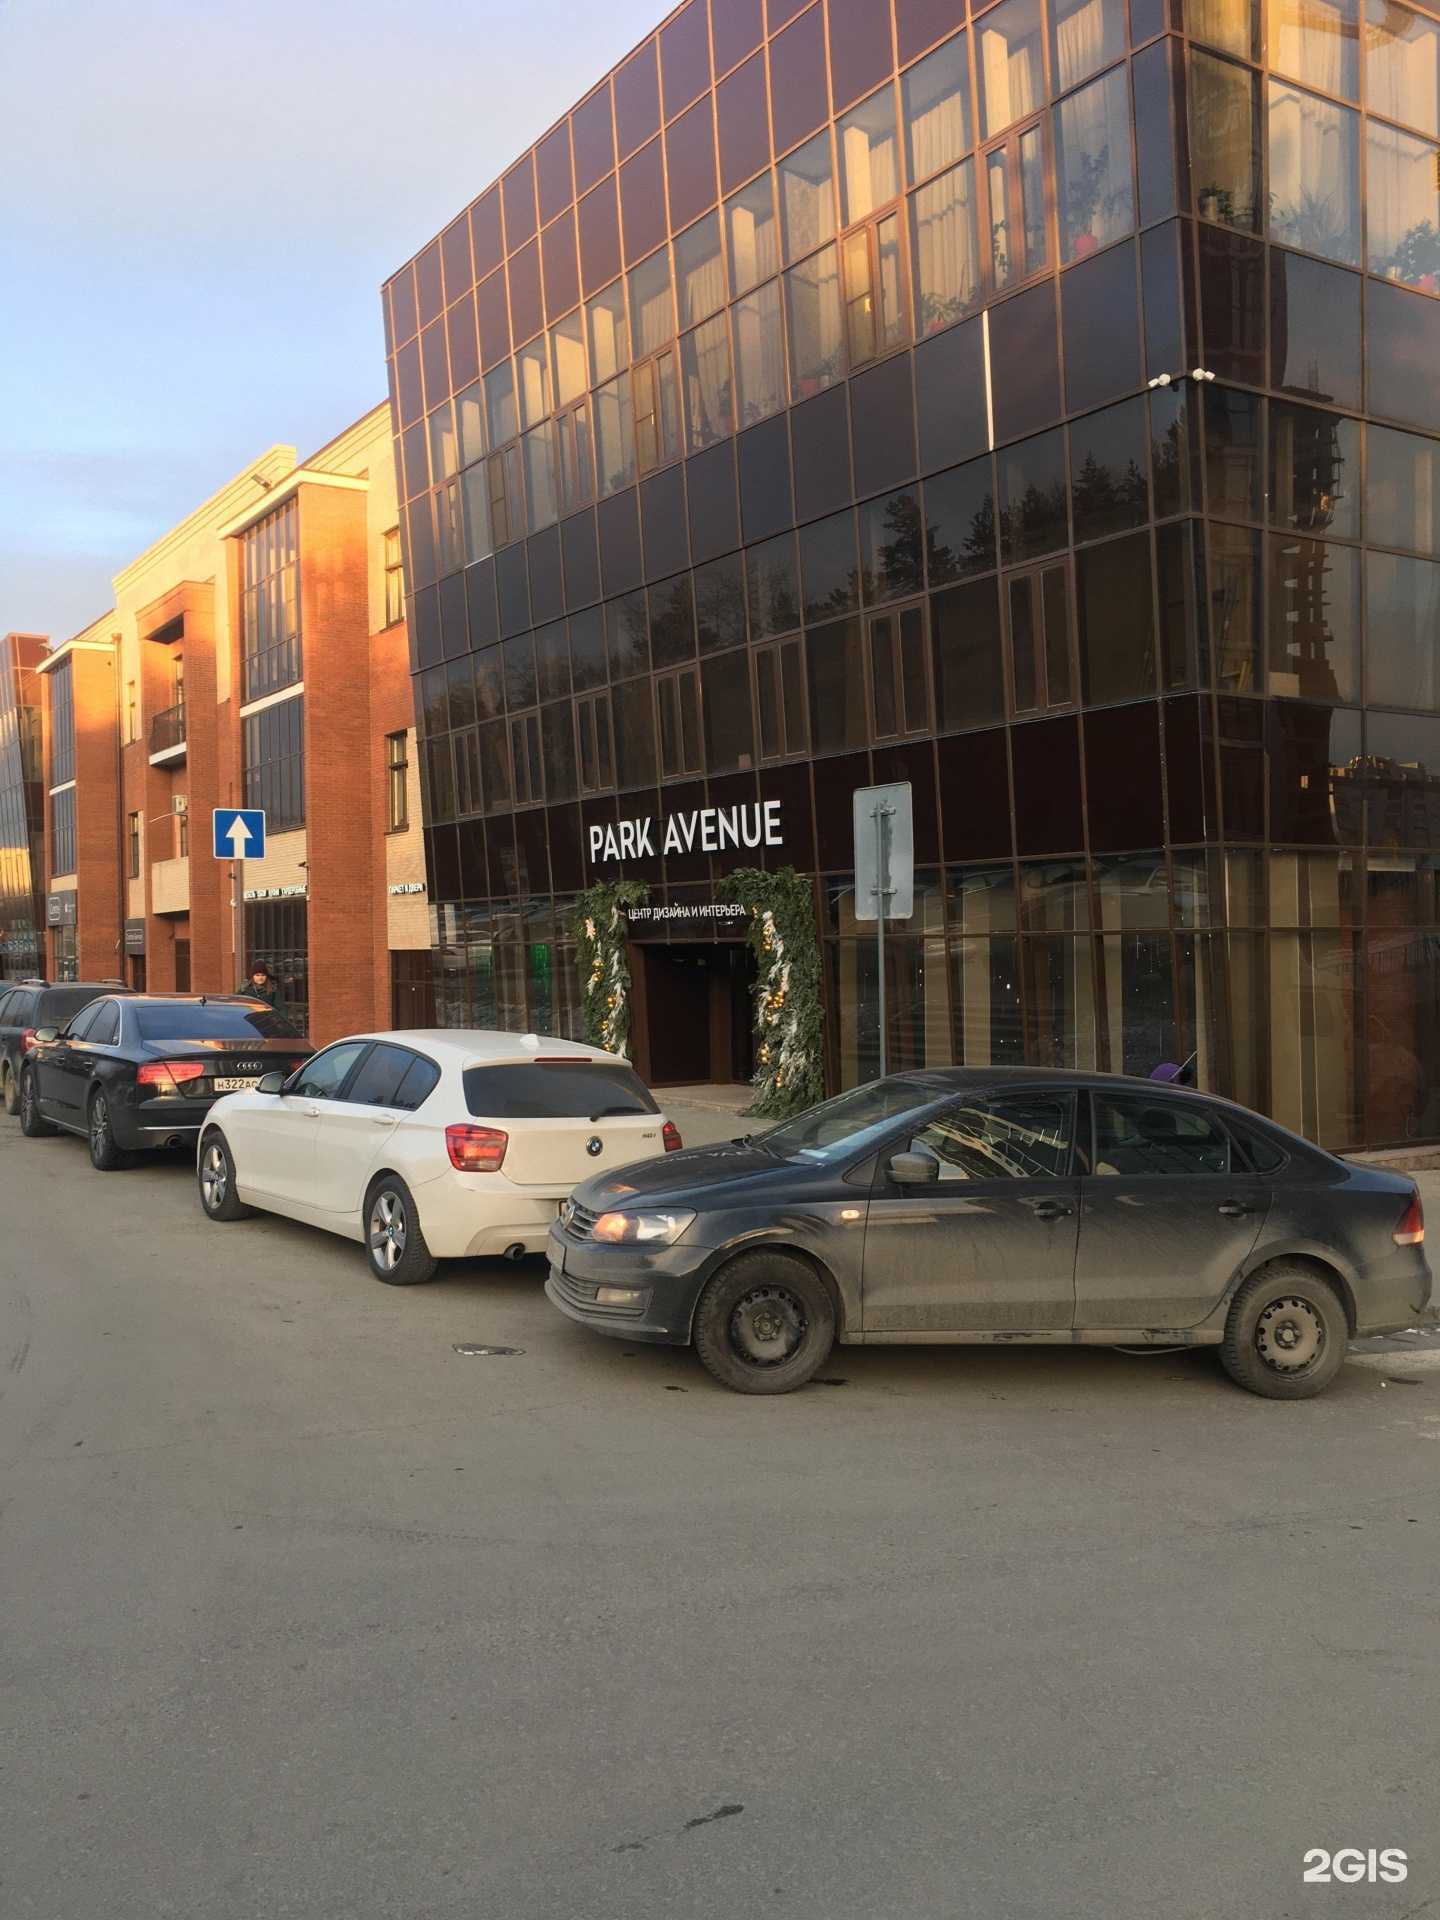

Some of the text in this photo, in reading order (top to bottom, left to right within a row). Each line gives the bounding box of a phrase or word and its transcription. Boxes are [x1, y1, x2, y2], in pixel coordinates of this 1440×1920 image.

[590, 800, 783, 864] PARK AVENUE
[628, 902, 746, 921] ЦЕНТР ДИЗАЙНА И ИНТЕРЬЕРА
